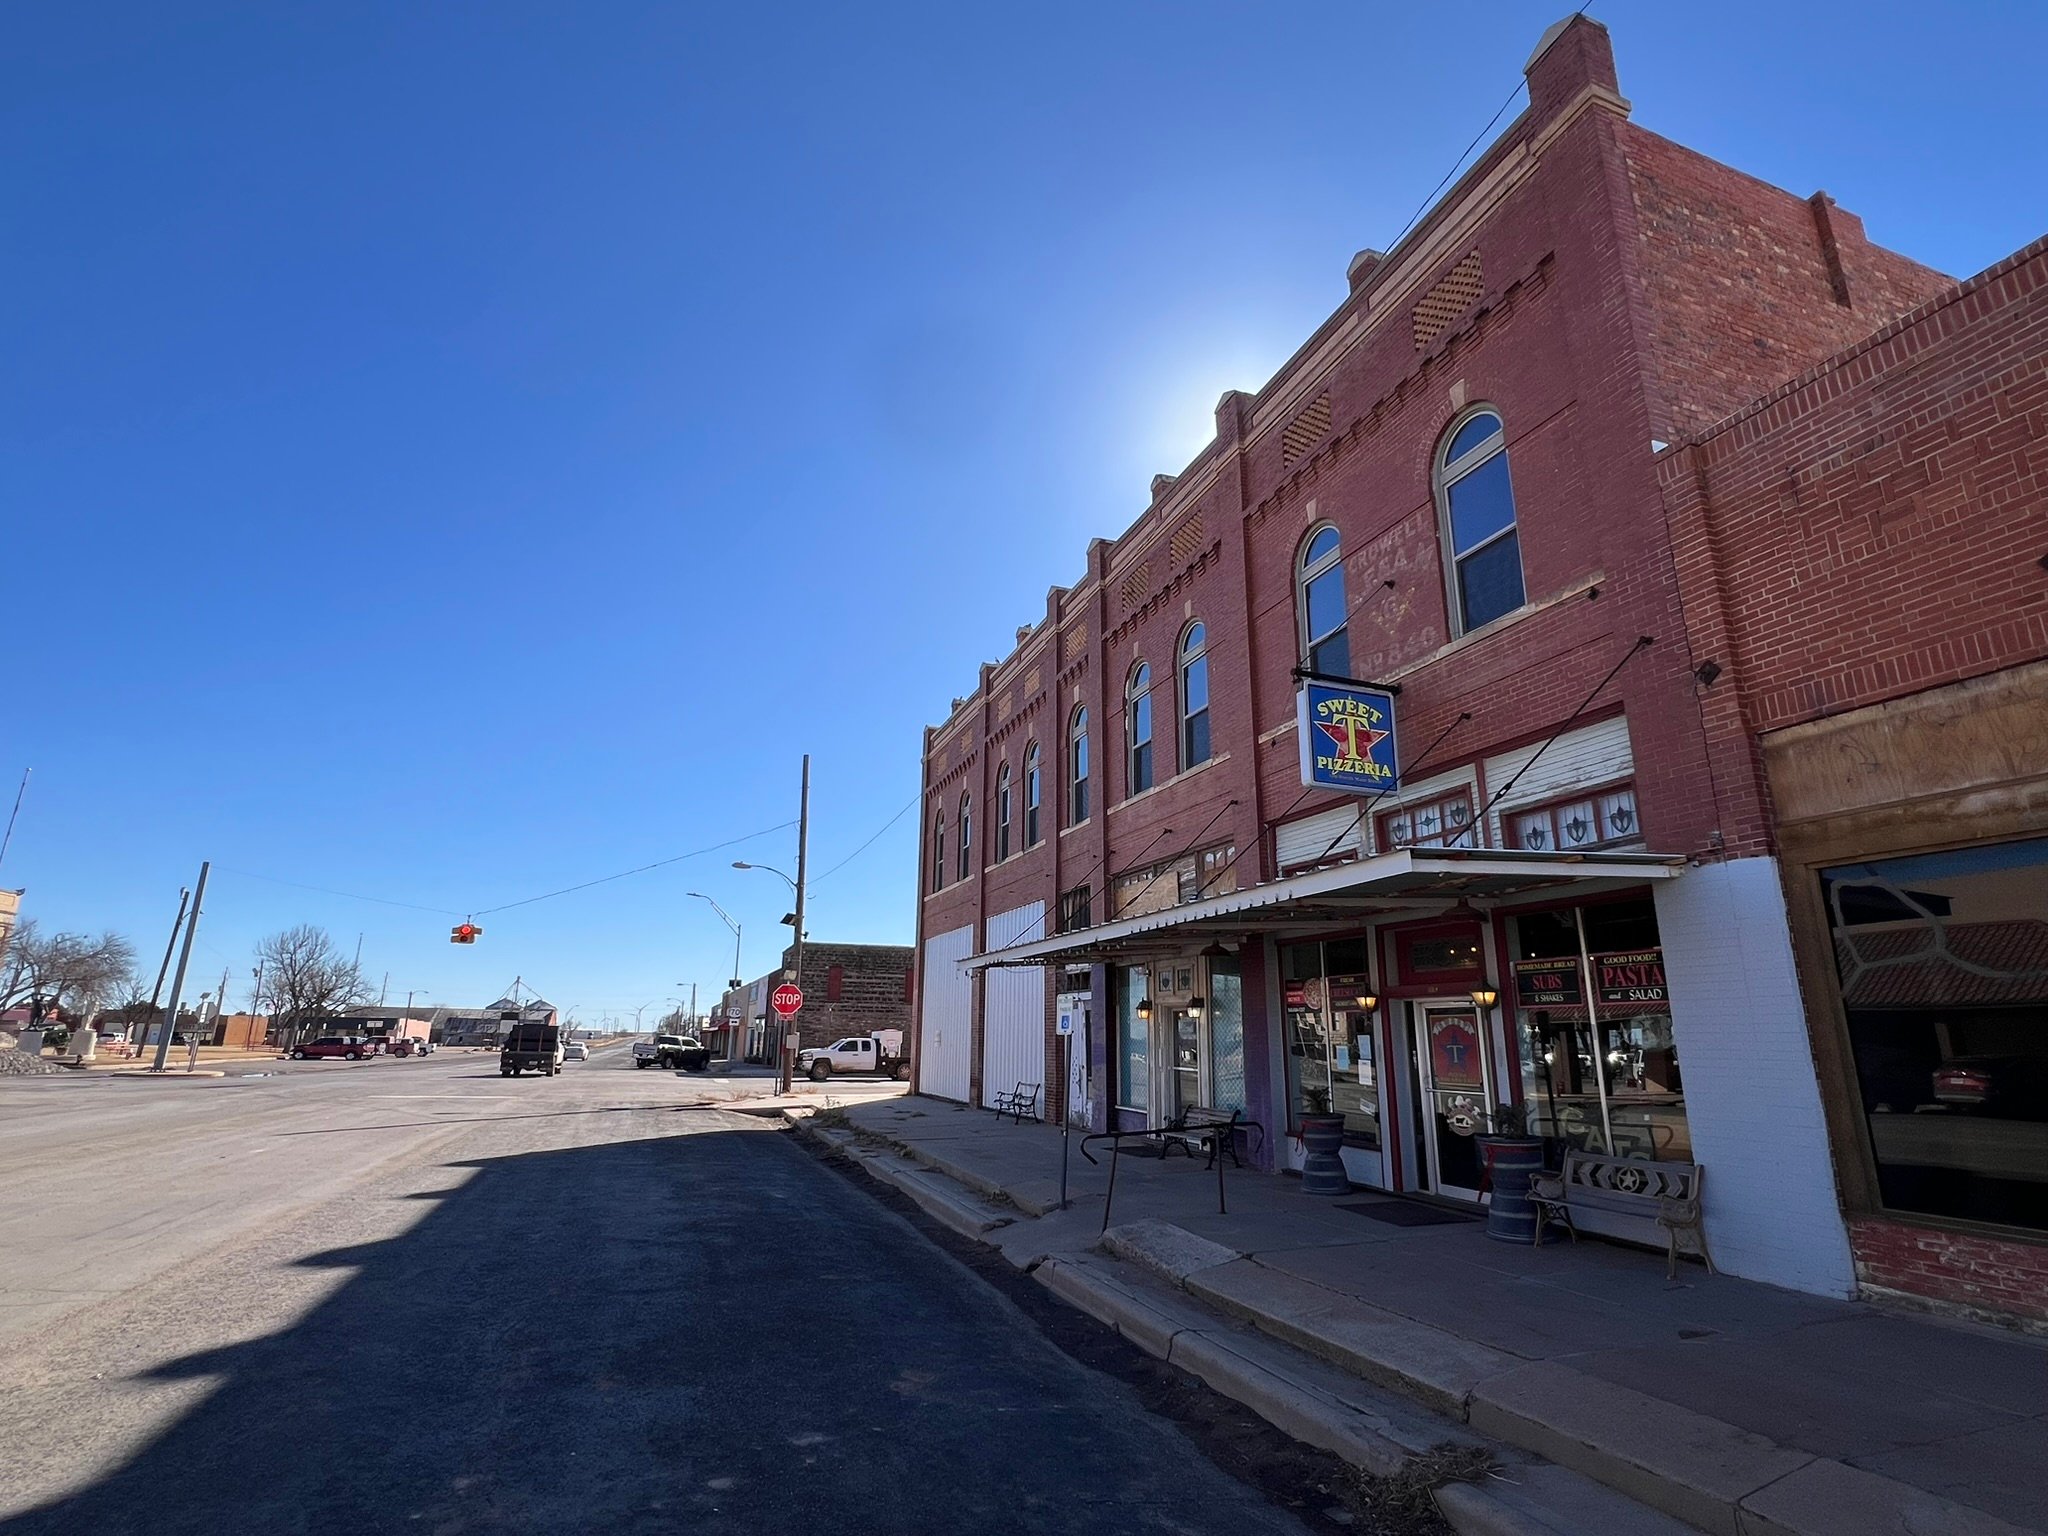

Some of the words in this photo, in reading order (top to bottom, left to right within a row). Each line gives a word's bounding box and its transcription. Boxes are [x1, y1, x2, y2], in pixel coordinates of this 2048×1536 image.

[1317, 699, 1383, 723] SWEET
[1332, 713, 1370, 760] T
[1317, 756, 1392, 777] PIZZERIA
[1516, 962, 1552, 971] HOMEMADE
[1553, 960, 1576, 969] BREAD
[1603, 955, 1627, 965] GOOD
[1532, 973, 1562, 990] SUBS
[1602, 964, 1665, 988] PASTA
[774, 993, 801, 1005] STOP
[1540, 992, 1564, 1002] SHAKES
[1629, 988, 1662, 1001] SALAD
